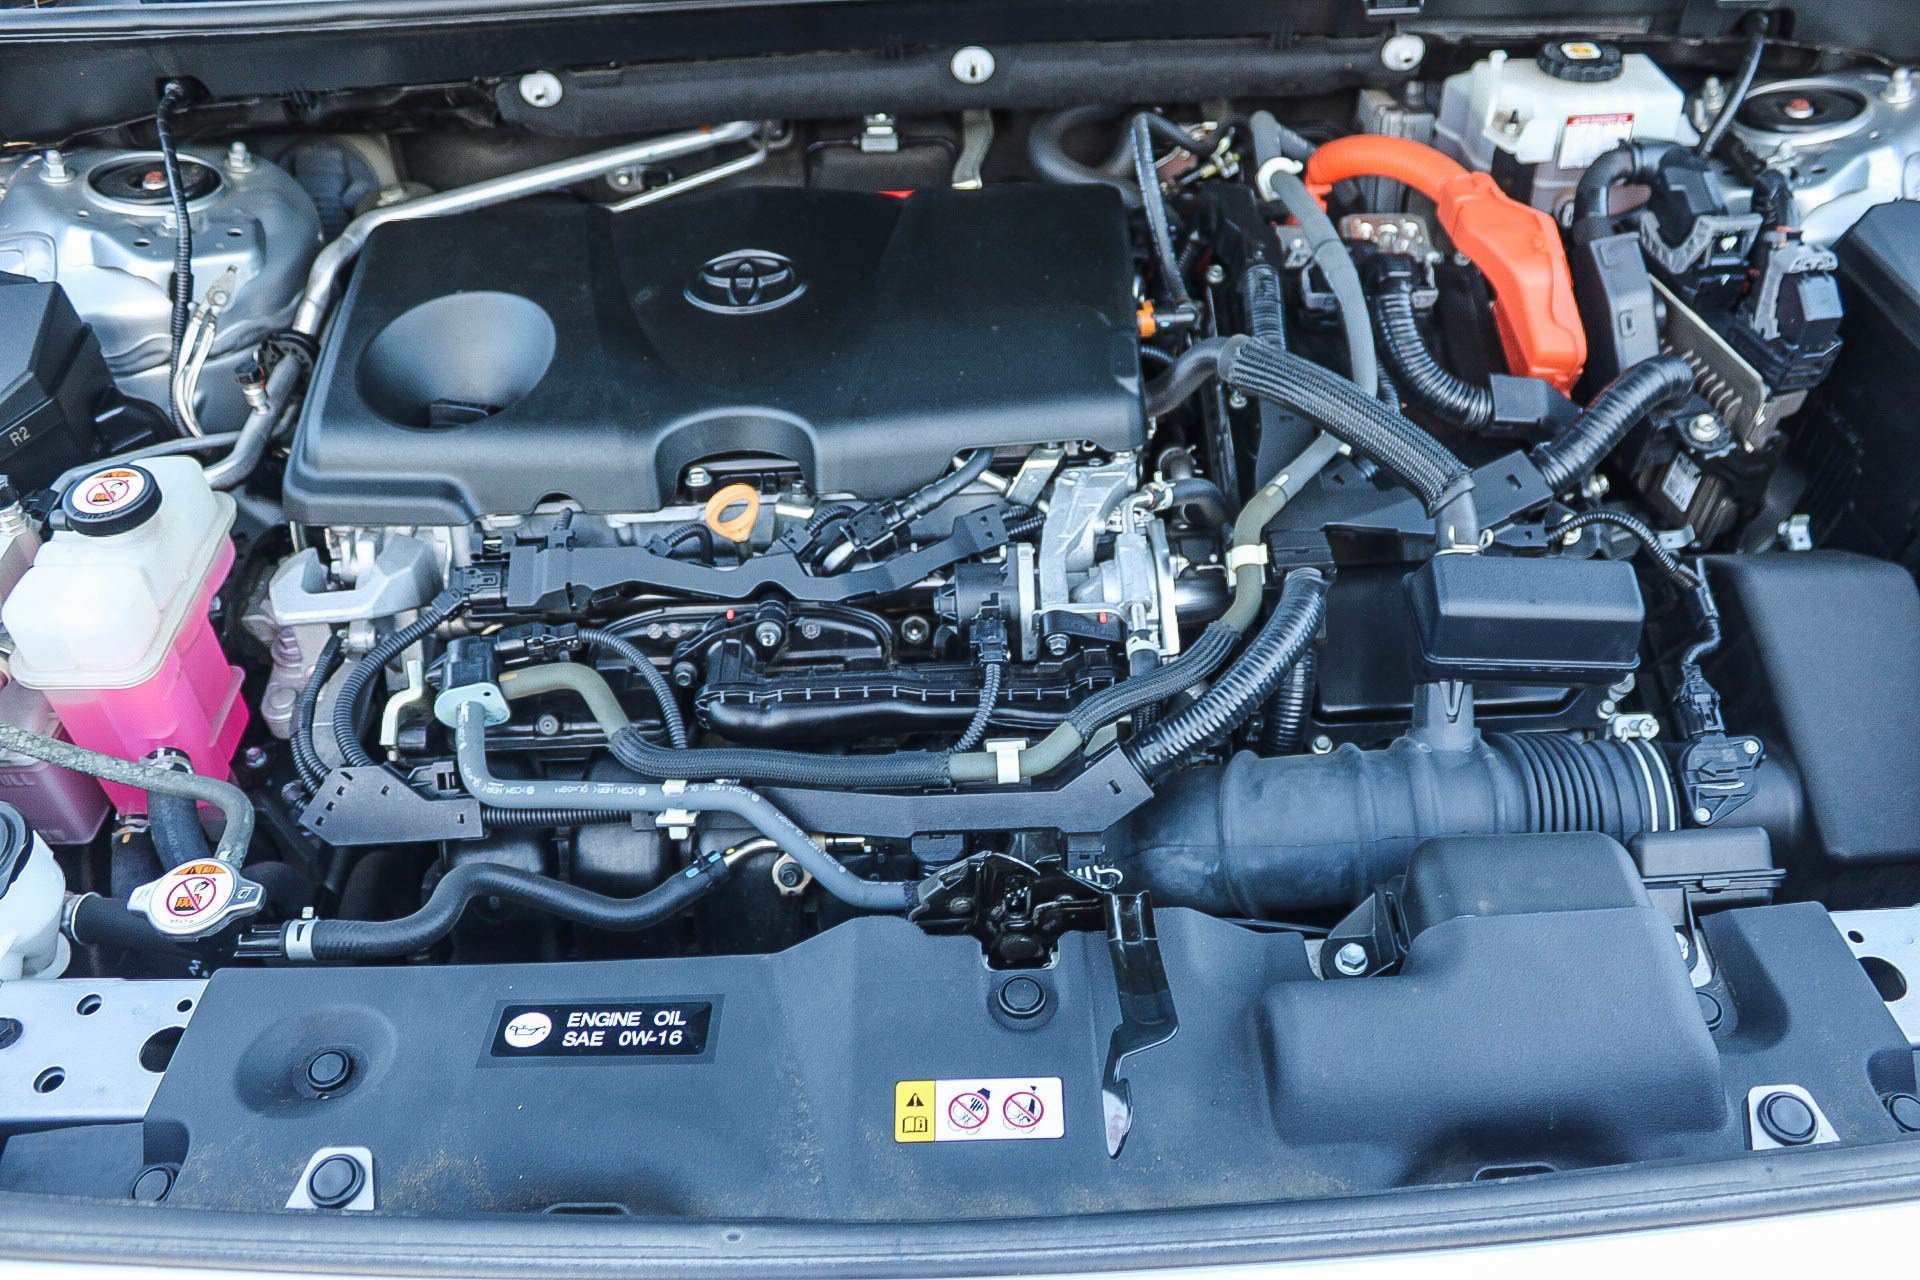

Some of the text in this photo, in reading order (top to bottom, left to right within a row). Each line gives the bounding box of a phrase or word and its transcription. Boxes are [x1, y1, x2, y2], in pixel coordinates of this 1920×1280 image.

[9, 426, 30, 446] R2
[567, 1010, 687, 1028] ENGINE OIL
[562, 1030, 683, 1047] SAE 0W-16
